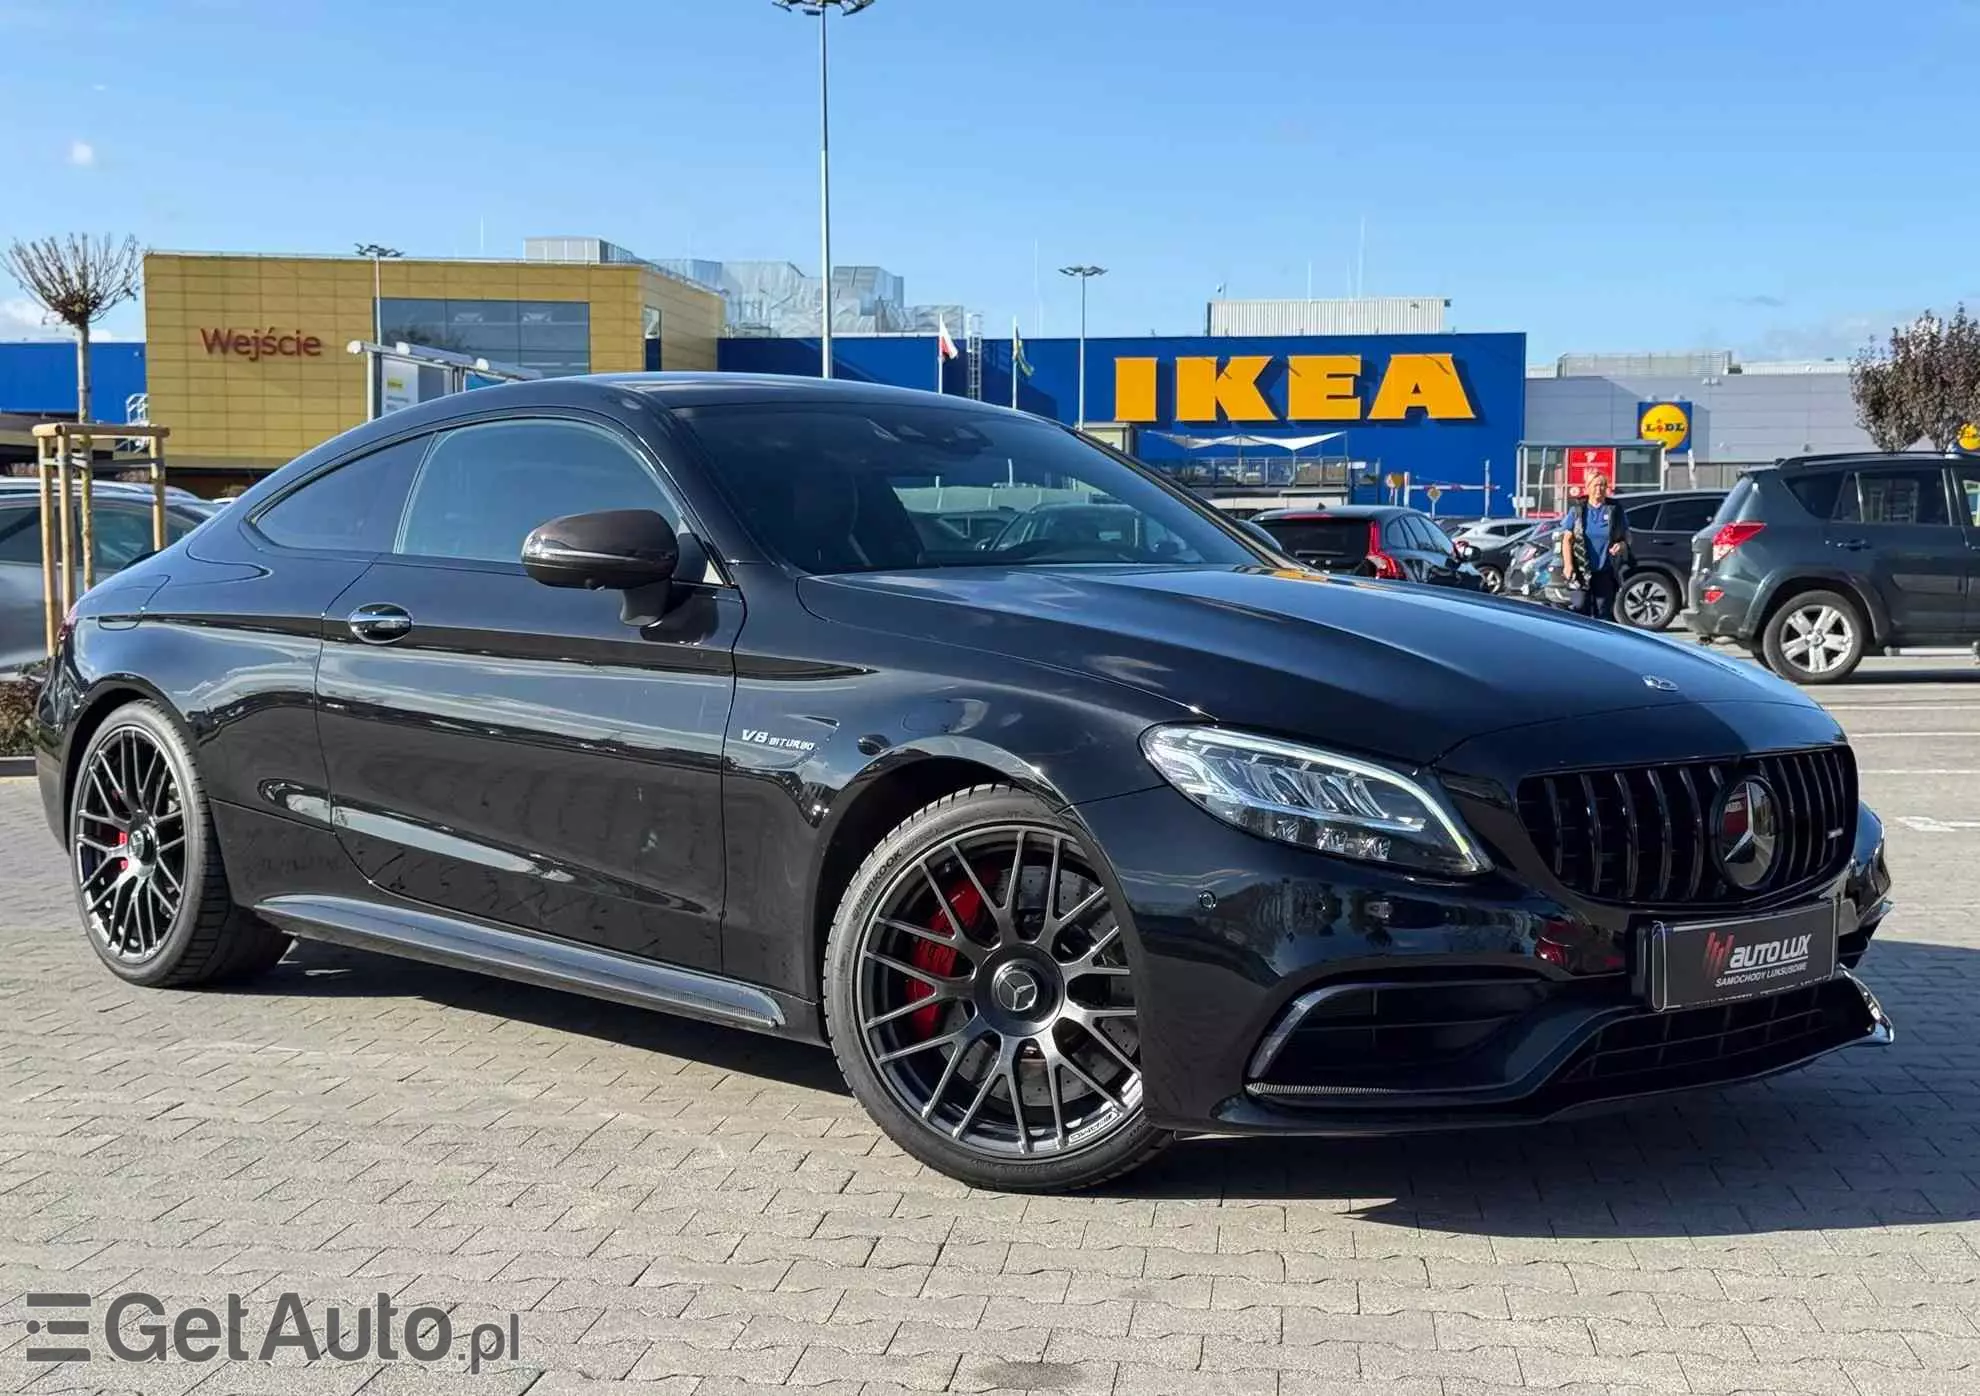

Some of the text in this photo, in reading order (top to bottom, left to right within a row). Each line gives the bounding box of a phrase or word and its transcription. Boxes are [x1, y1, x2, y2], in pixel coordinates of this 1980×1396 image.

[200, 327, 323, 361] Wejście
[1114, 353, 1476, 423] IKEA
[742, 729, 769, 744] V8
[1780, 933, 1812, 960] LUX
